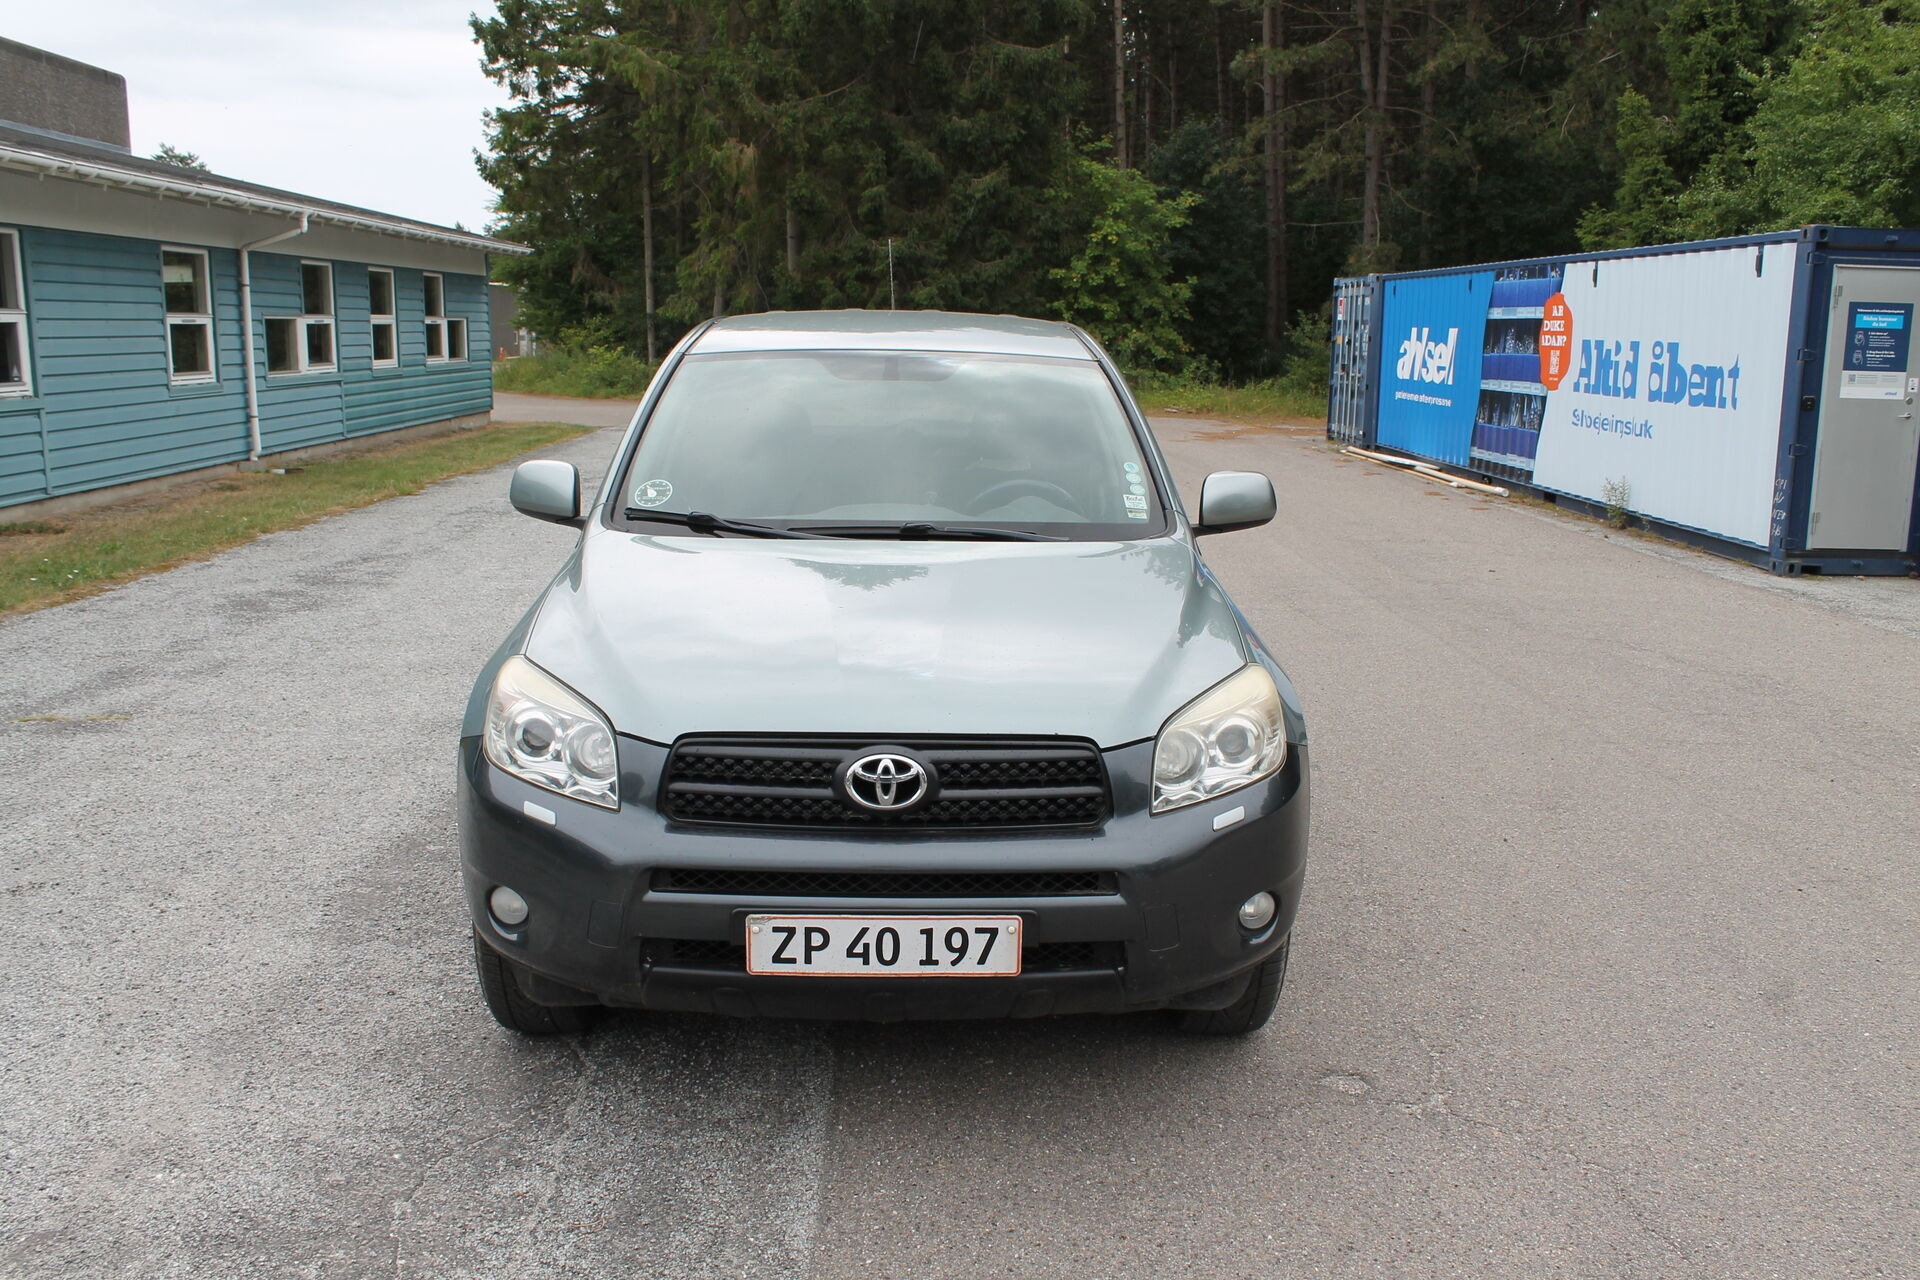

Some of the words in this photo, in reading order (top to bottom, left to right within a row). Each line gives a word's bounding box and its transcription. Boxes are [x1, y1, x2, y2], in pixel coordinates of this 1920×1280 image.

[1573, 338, 1641, 400] Altid
[1648, 340, 1740, 411] åbent
[771, 926, 831, 966] ZP
[846, 926, 901, 967] 40
[918, 926, 1000, 968] 197
